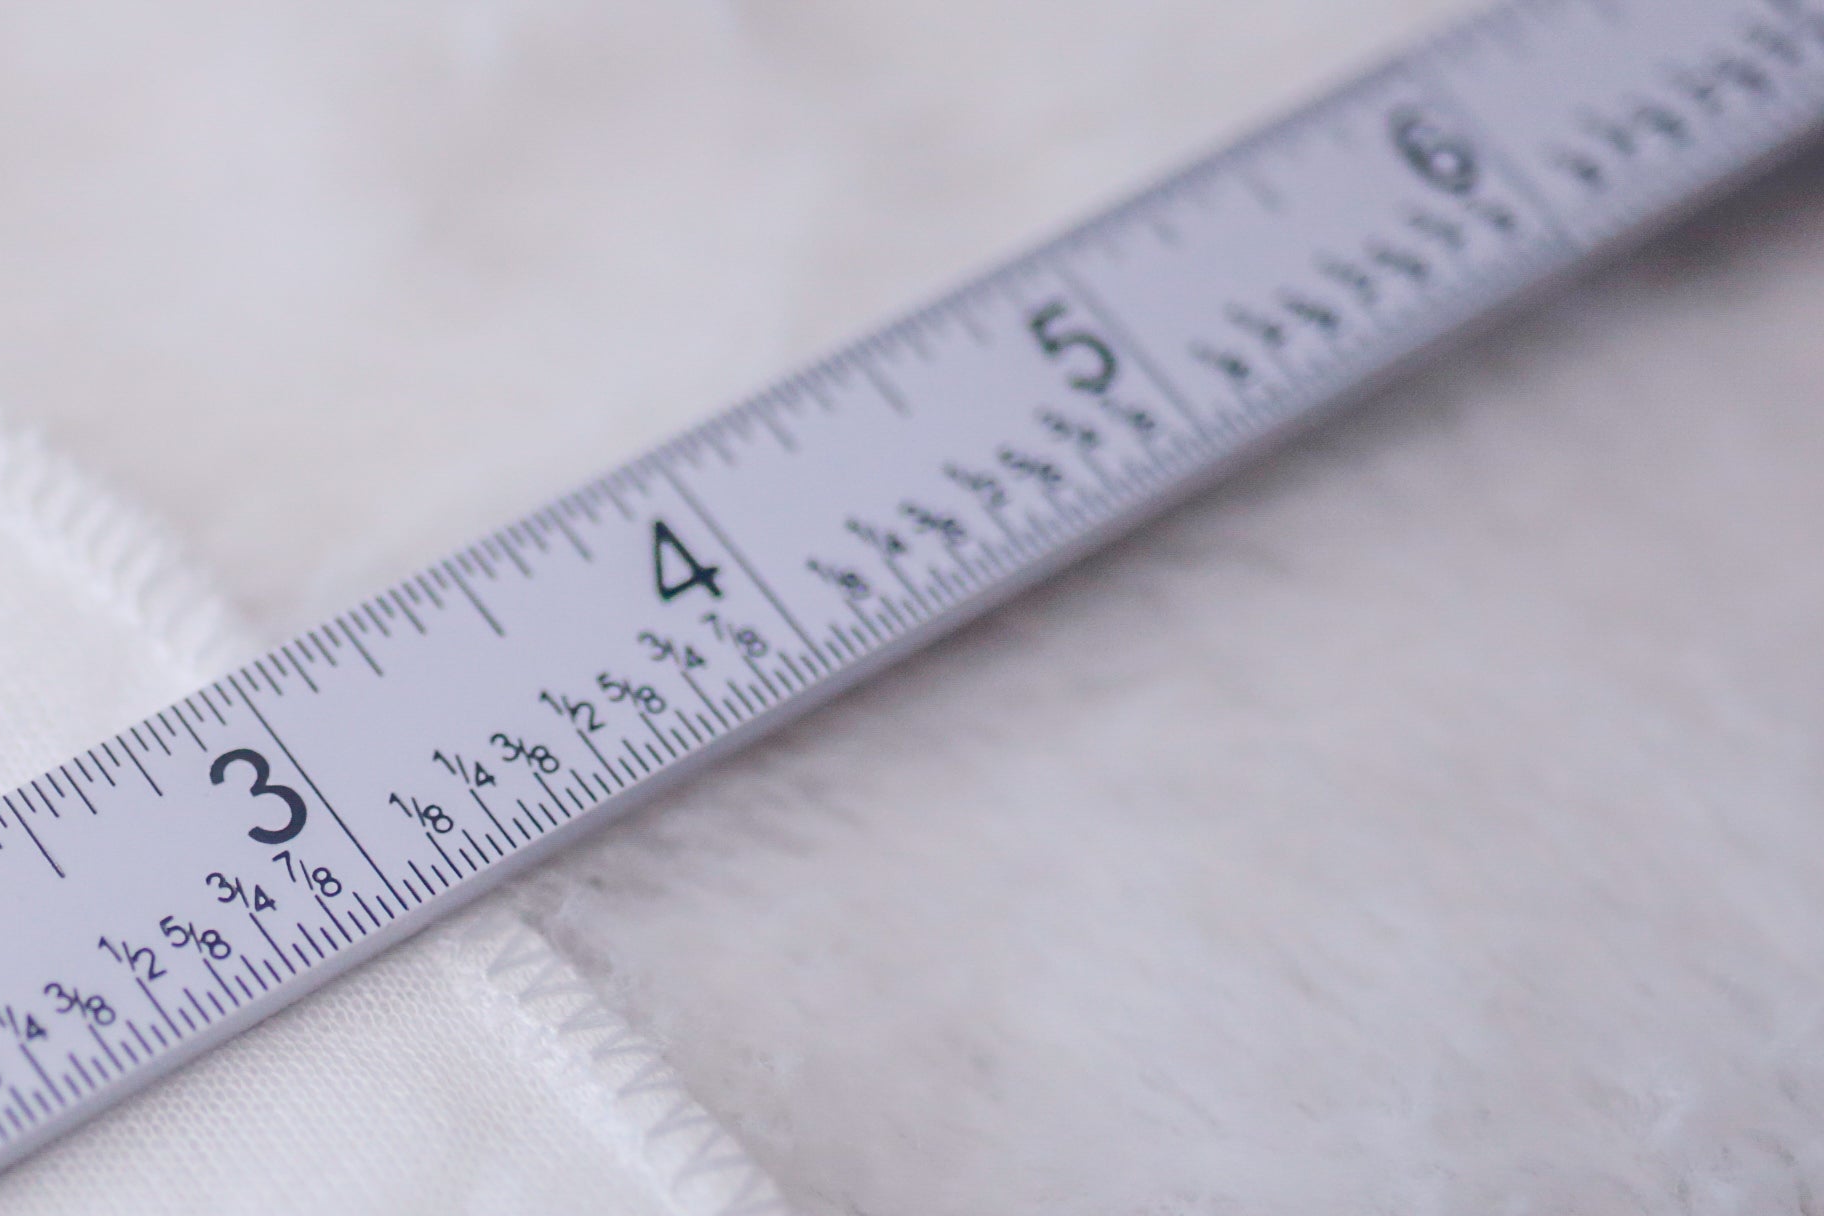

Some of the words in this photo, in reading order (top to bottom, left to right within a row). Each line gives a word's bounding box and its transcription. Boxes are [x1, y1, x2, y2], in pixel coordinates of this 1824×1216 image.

[1388, 105, 1477, 196] 6
[1030, 302, 1116, 393] 5
[654, 520, 721, 599] 4
[209, 748, 307, 844] 3
